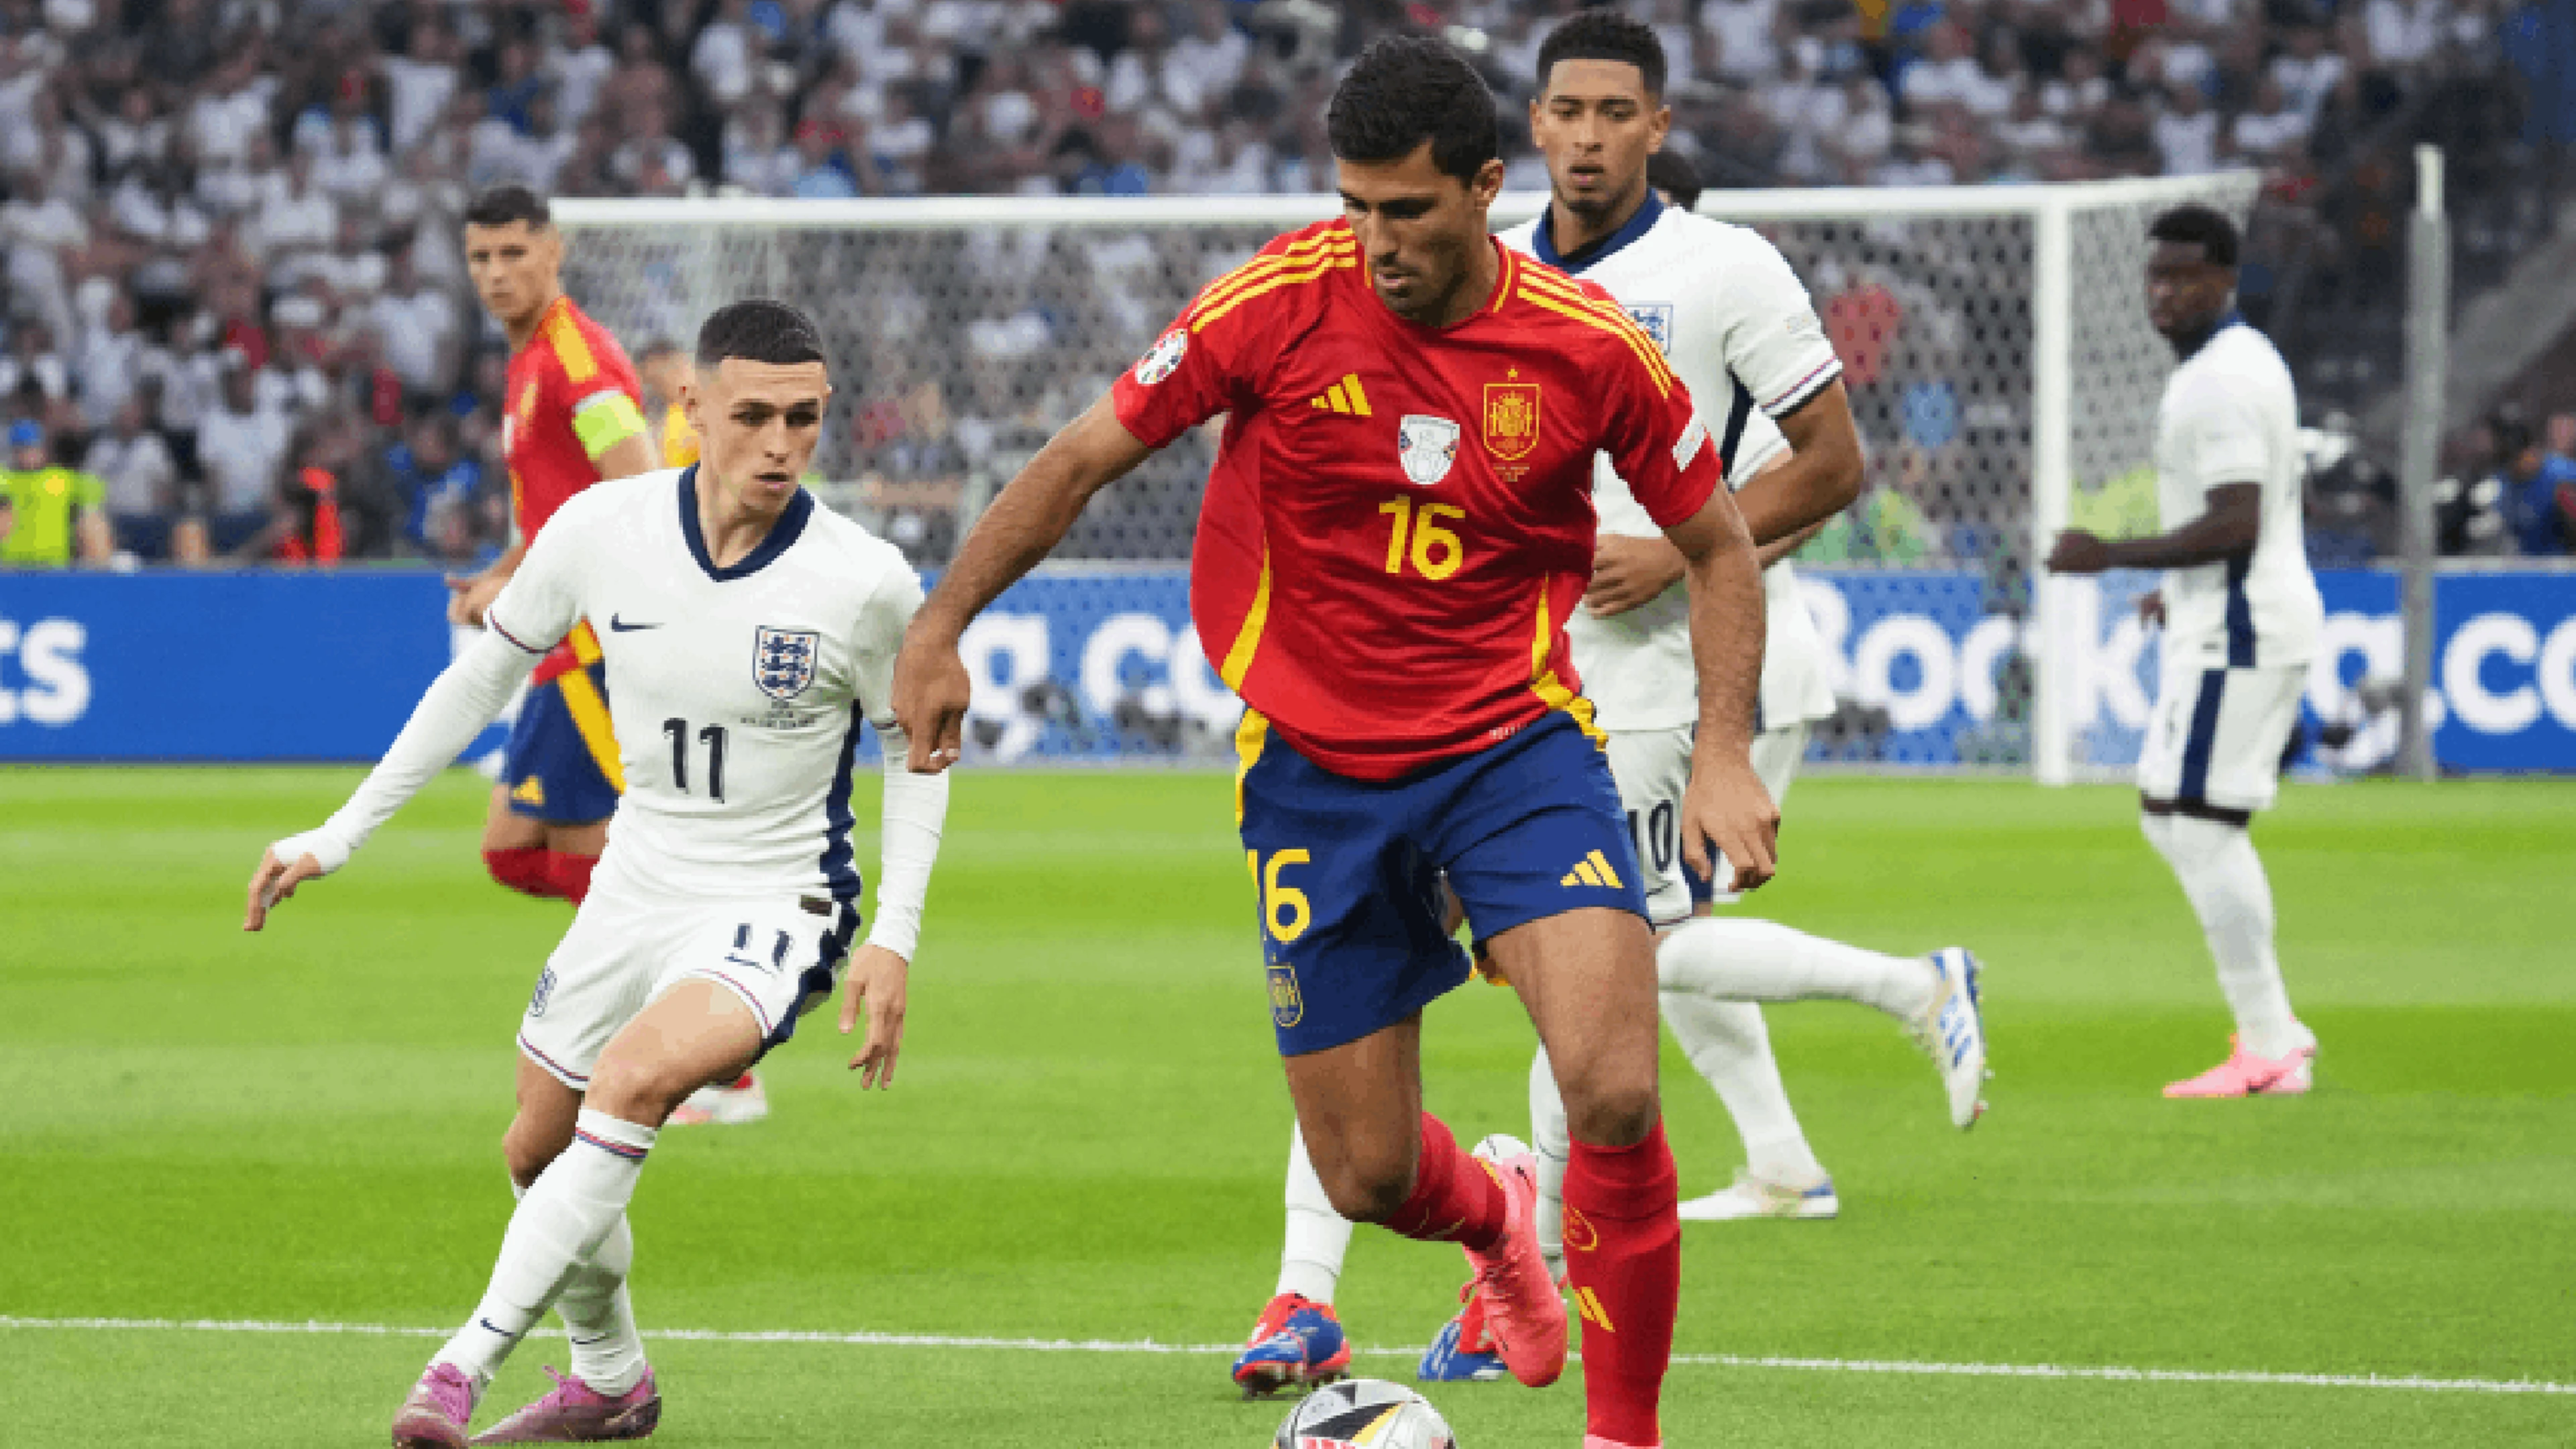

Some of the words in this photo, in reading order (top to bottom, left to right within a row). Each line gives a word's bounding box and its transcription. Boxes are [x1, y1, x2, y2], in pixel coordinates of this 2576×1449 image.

[1379, 494, 1465, 581] 16
[0, 616, 94, 729] s
[958, 612, 1245, 762] gco
[1794, 577, 2576, 769] ookg.c
[663, 717, 728, 804] 11
